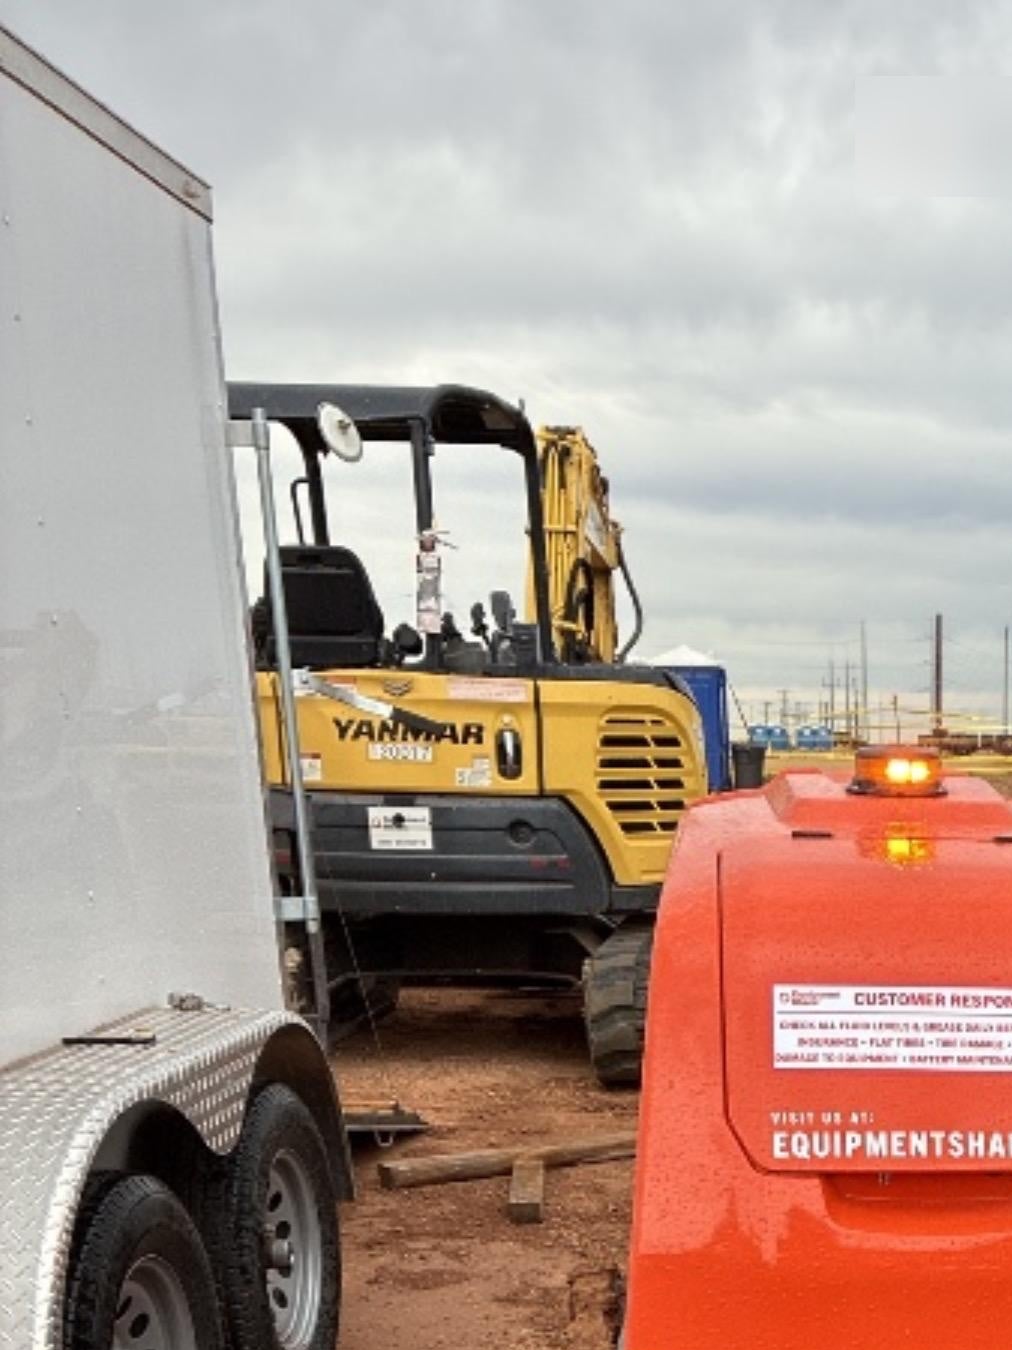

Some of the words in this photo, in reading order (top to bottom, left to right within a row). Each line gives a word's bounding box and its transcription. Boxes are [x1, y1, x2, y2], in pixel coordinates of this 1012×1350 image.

[854, 992, 946, 1007] CUSTOMER
[769, 1111, 814, 1125] VISIT
[821, 1111, 842, 1125] US
